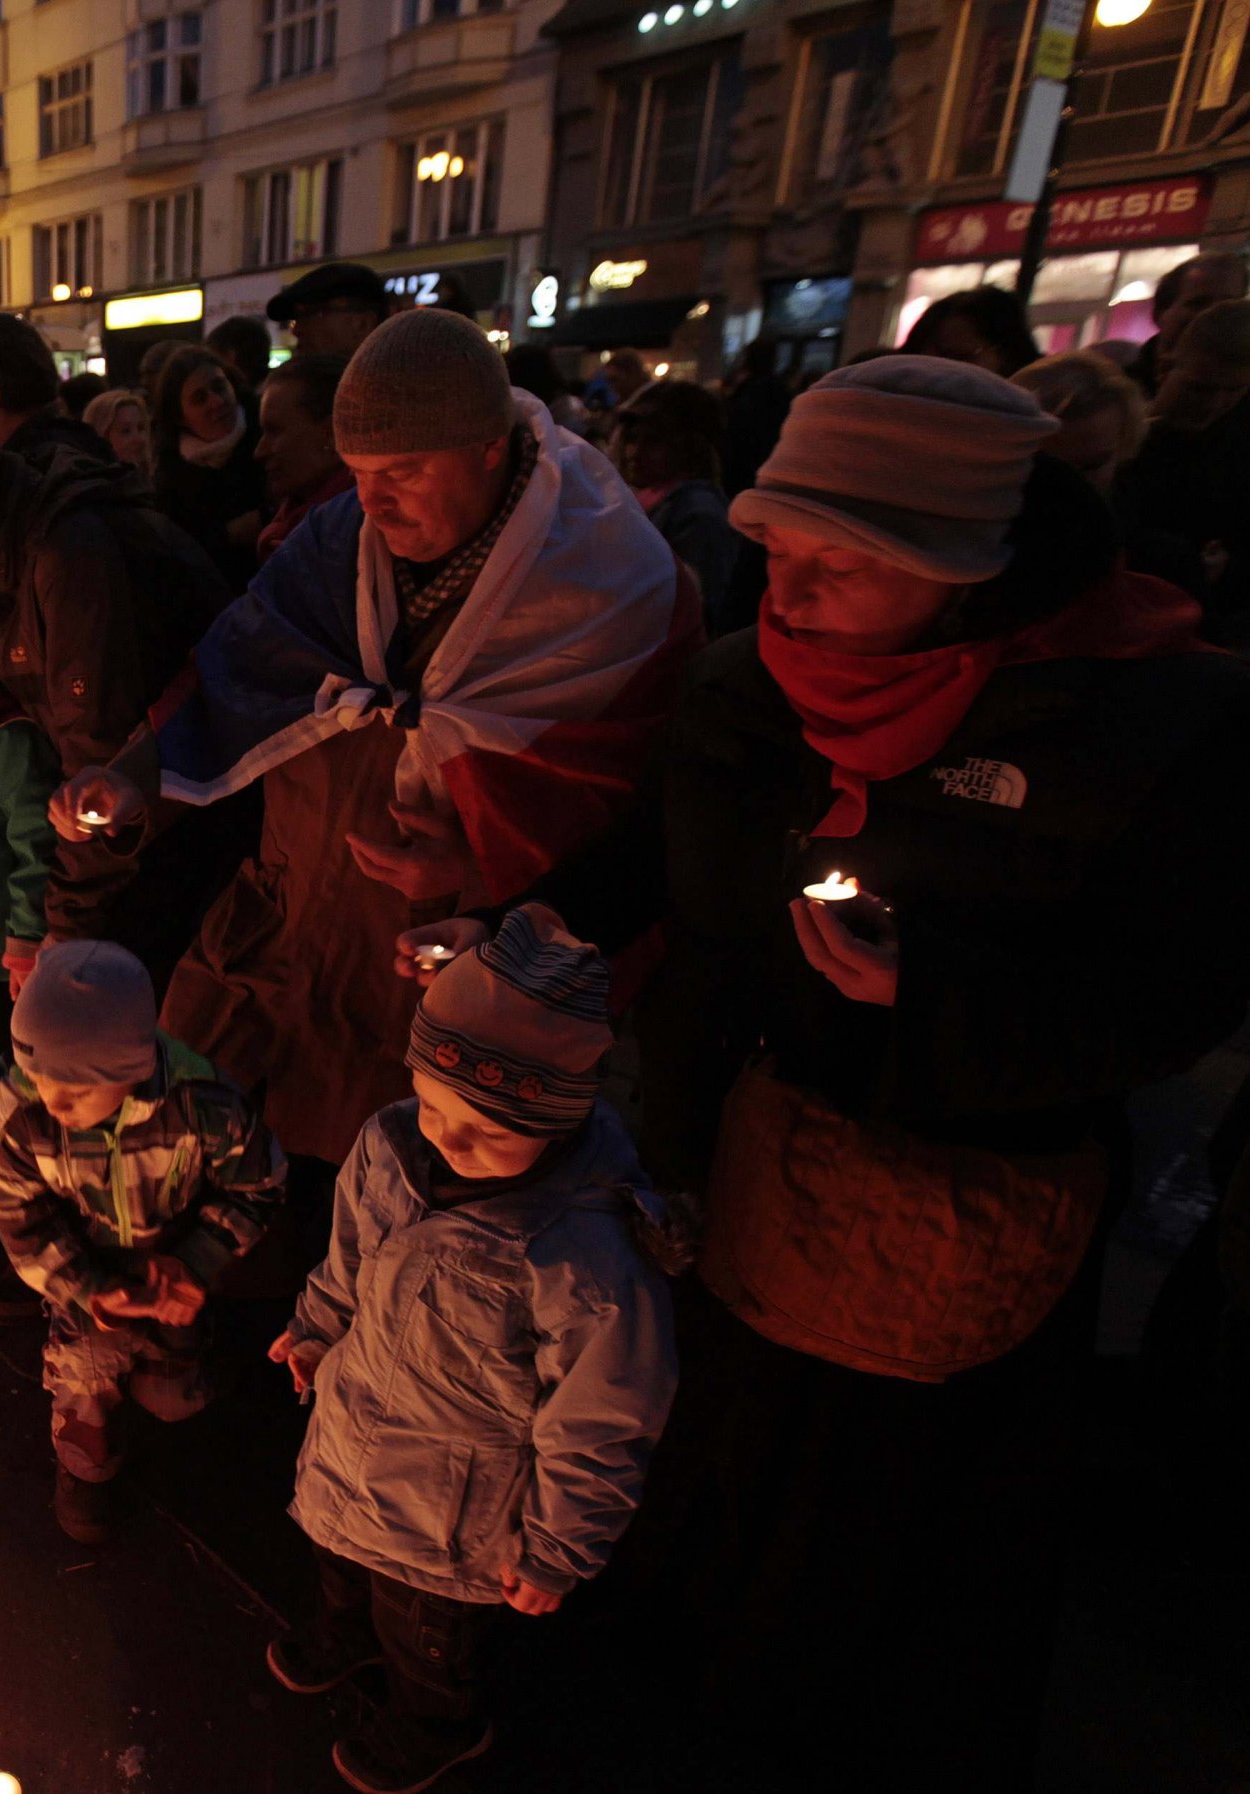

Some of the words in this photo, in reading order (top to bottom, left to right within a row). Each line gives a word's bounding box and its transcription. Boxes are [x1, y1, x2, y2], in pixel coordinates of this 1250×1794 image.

[1005, 186, 1199, 231] GNESIS
[964, 758, 1003, 774] THE
[930, 766, 998, 789] NORTH
[942, 781, 991, 803] FACE
